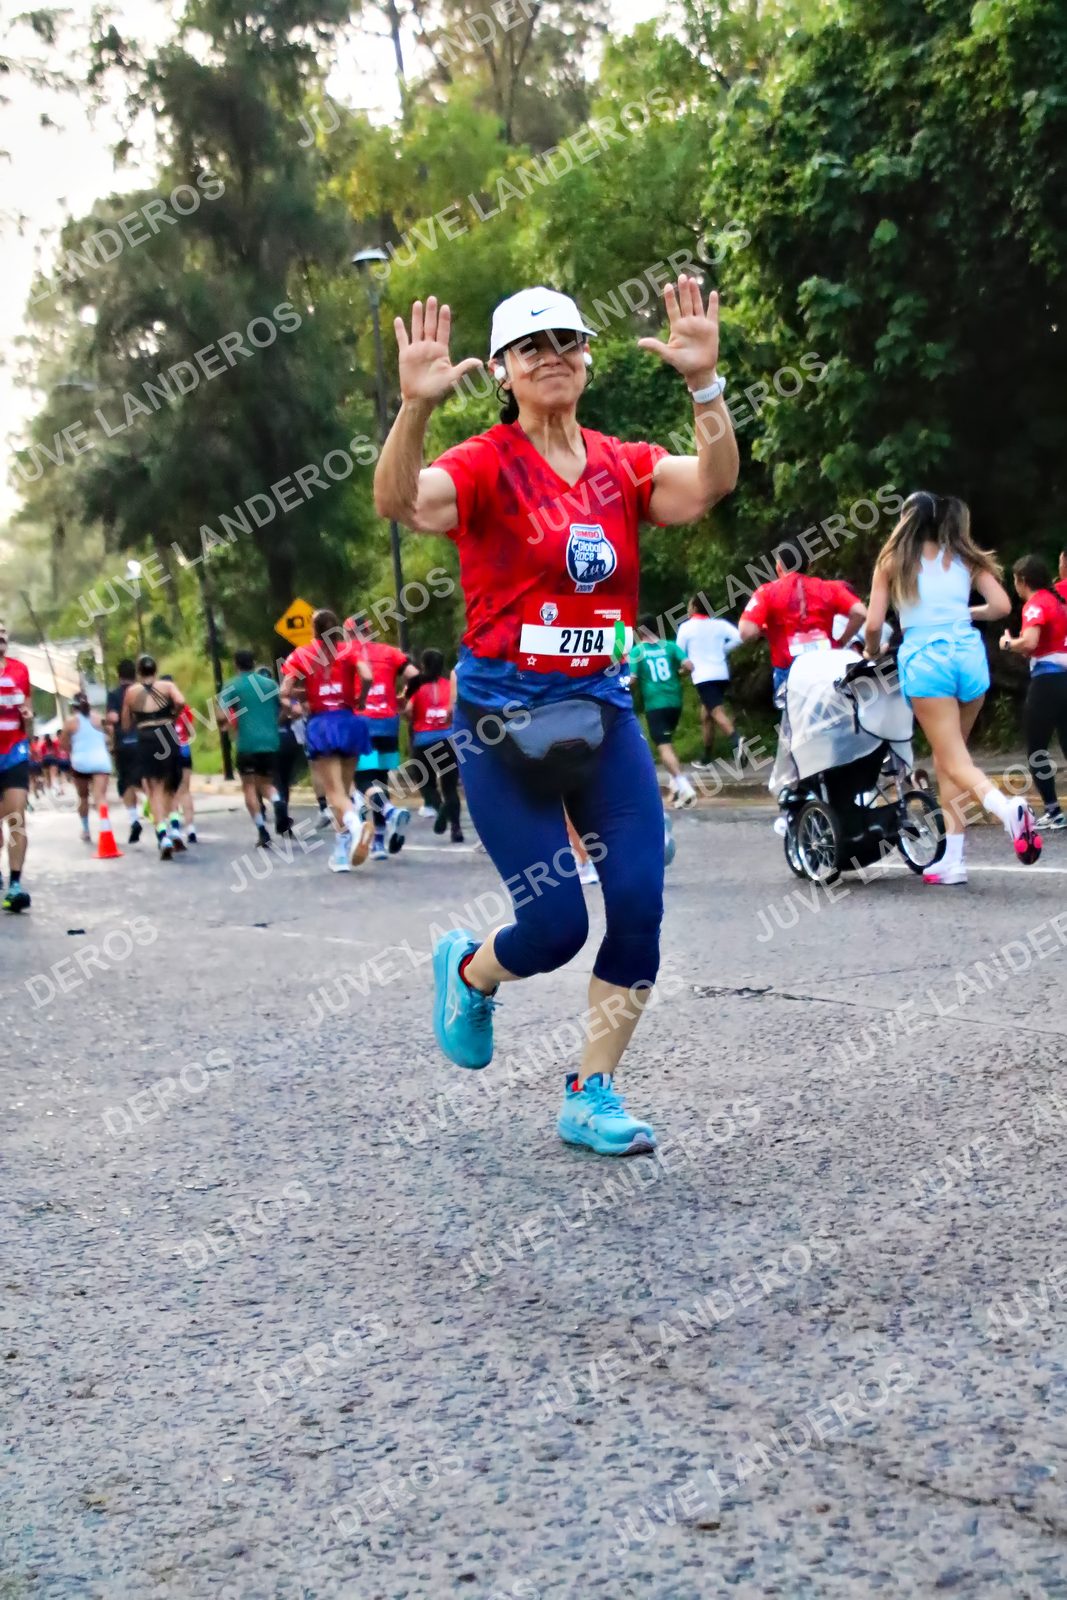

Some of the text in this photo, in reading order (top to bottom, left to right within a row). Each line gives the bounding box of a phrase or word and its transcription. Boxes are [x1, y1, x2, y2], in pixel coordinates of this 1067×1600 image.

[574, 549, 594, 561] Race
[578, 540, 601, 552] Global
[559, 629, 604, 653] 2764
[646, 657, 671, 682] 18
